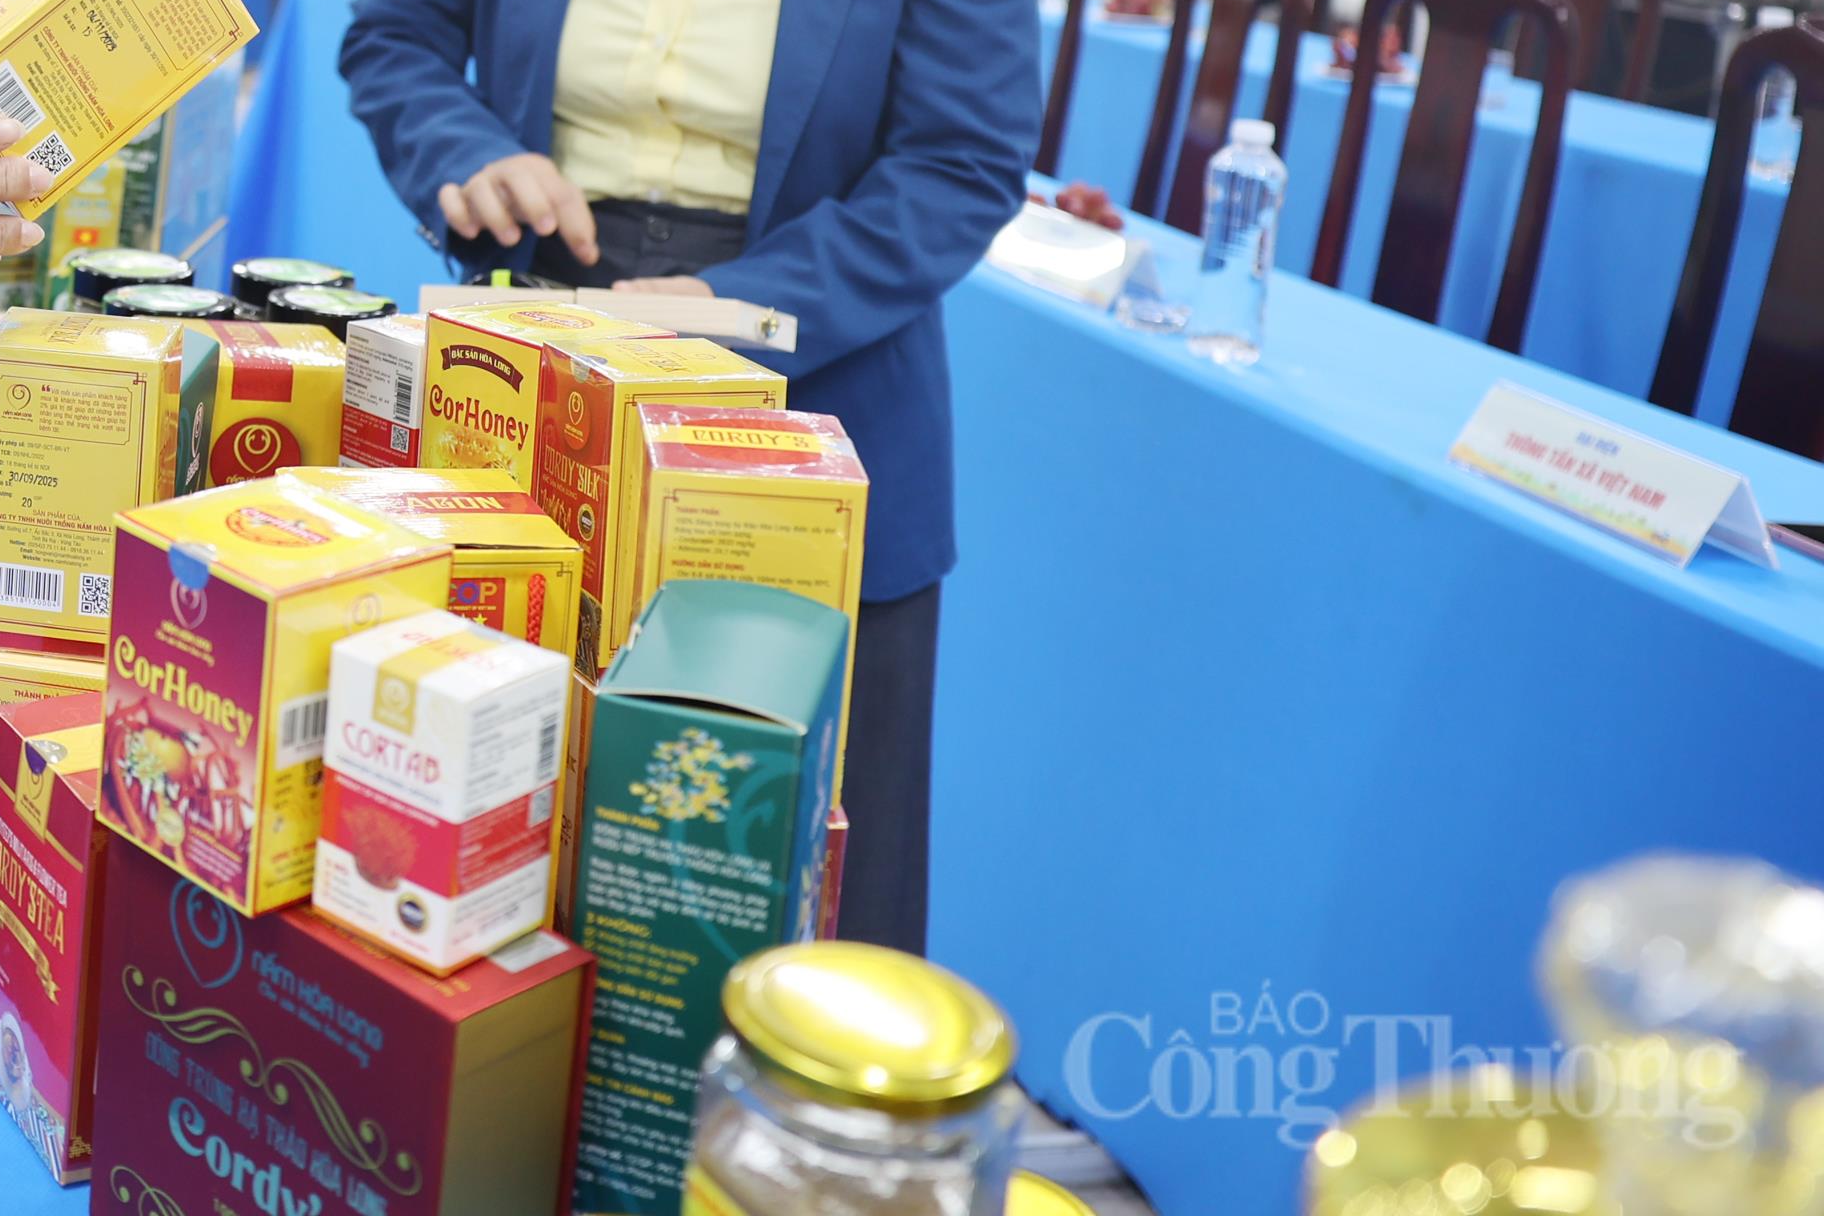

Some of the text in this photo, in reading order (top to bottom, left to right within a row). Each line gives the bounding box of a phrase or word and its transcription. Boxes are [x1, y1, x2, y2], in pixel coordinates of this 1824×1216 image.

[451, 348, 511, 376] ĐẶC SẢN HÒA LONG
[429, 384, 529, 451] CorHoney
[692, 430, 810, 449] CORDY'S
[9, 471, 58, 487] 30/09/2025
[22, 497, 32, 508] 20
[18, 515, 35, 523] TNHH
[36, 517, 53, 525] NUÔI
[54, 519, 75, 528] TRỒNG
[77, 521, 92, 530] NẤM
[32, 509, 46, 517] SẢN
[47, 510, 65, 520] PHẨM
[14, 690, 42, 699] THÀNH
[114, 635, 254, 748] CorHoney
